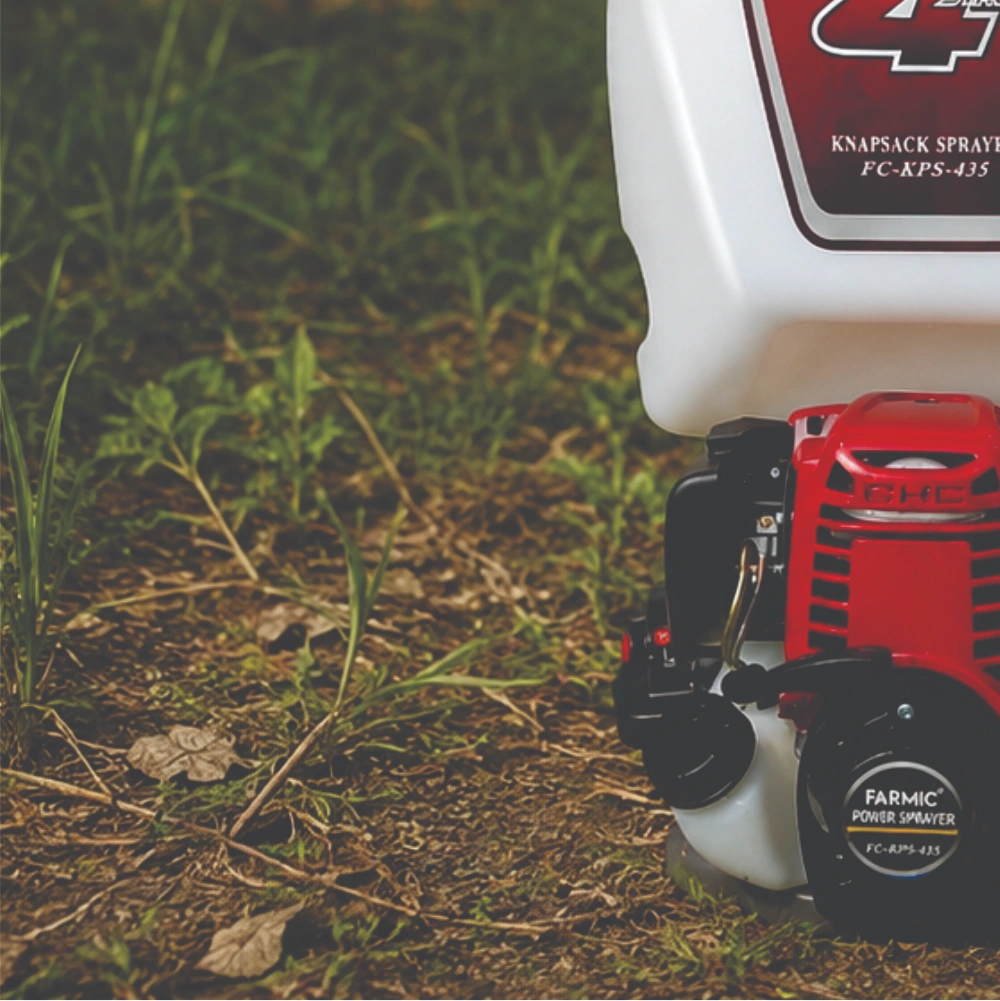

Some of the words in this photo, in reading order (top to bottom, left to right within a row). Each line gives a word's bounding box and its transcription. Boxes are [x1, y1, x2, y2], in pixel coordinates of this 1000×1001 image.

[831, 135, 930, 153] KNAPSACK
[860, 161, 990, 177] FC-KPS-435
[865, 789, 938, 807] FARMIC
